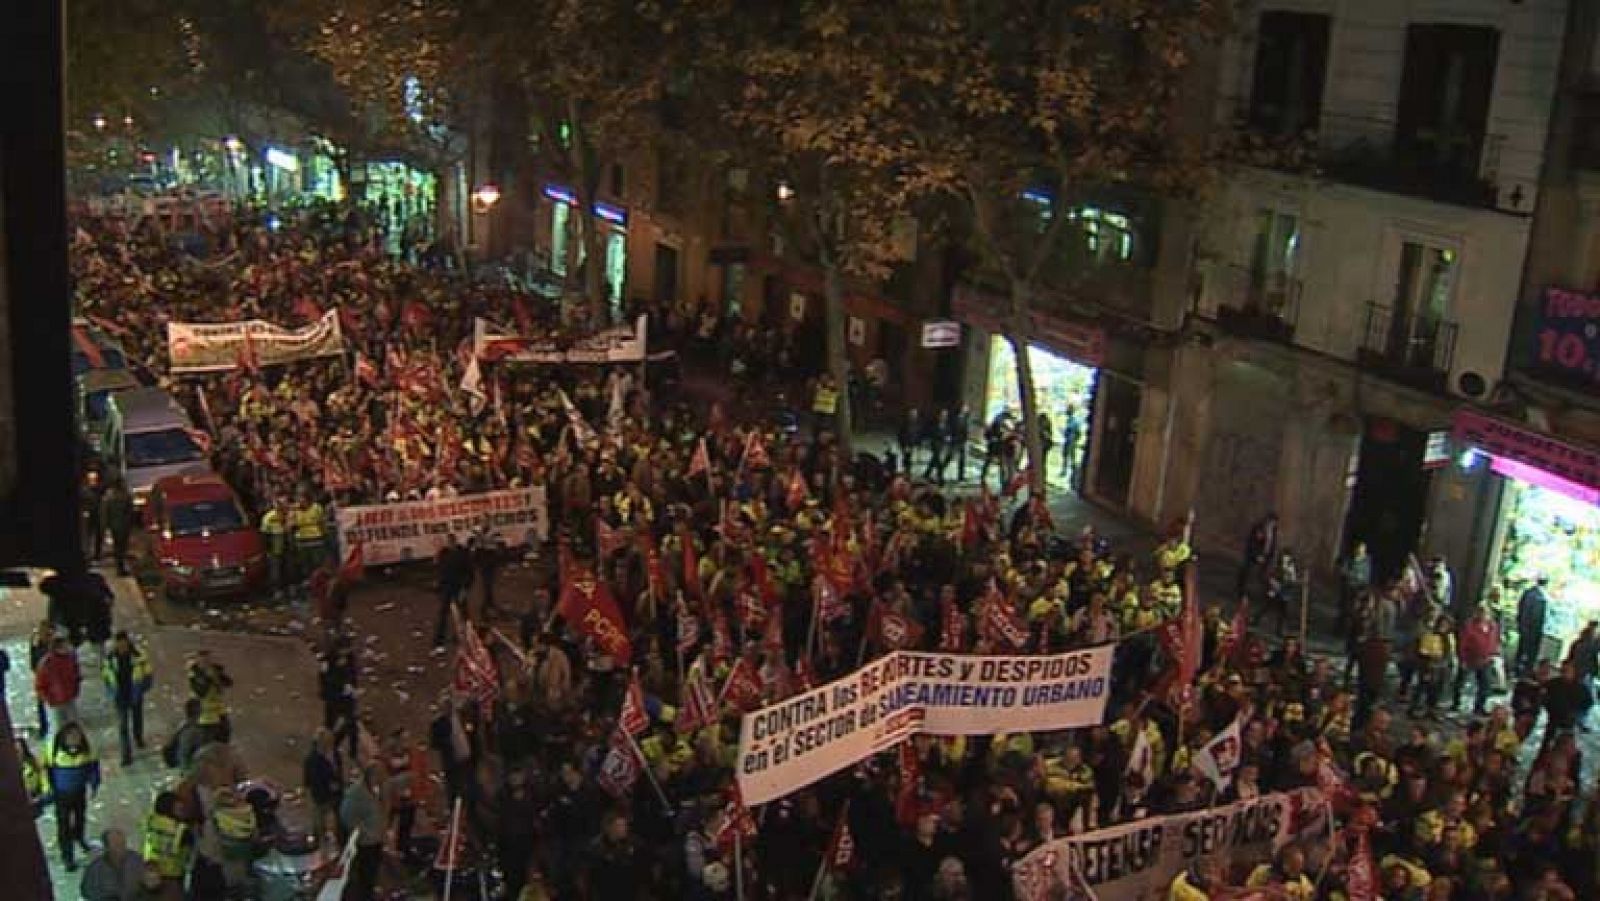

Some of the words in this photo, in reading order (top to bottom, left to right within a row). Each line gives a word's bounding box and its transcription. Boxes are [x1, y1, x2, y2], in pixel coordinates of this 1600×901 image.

[743, 750, 768, 775] en
[773, 736, 789, 765] el
[794, 709, 857, 756] SECTOR
[1022, 677, 1106, 707] URBANO
[753, 691, 827, 741] CONTRA
[832, 683, 858, 710] los
[980, 653, 1093, 682] DESPIDOS
